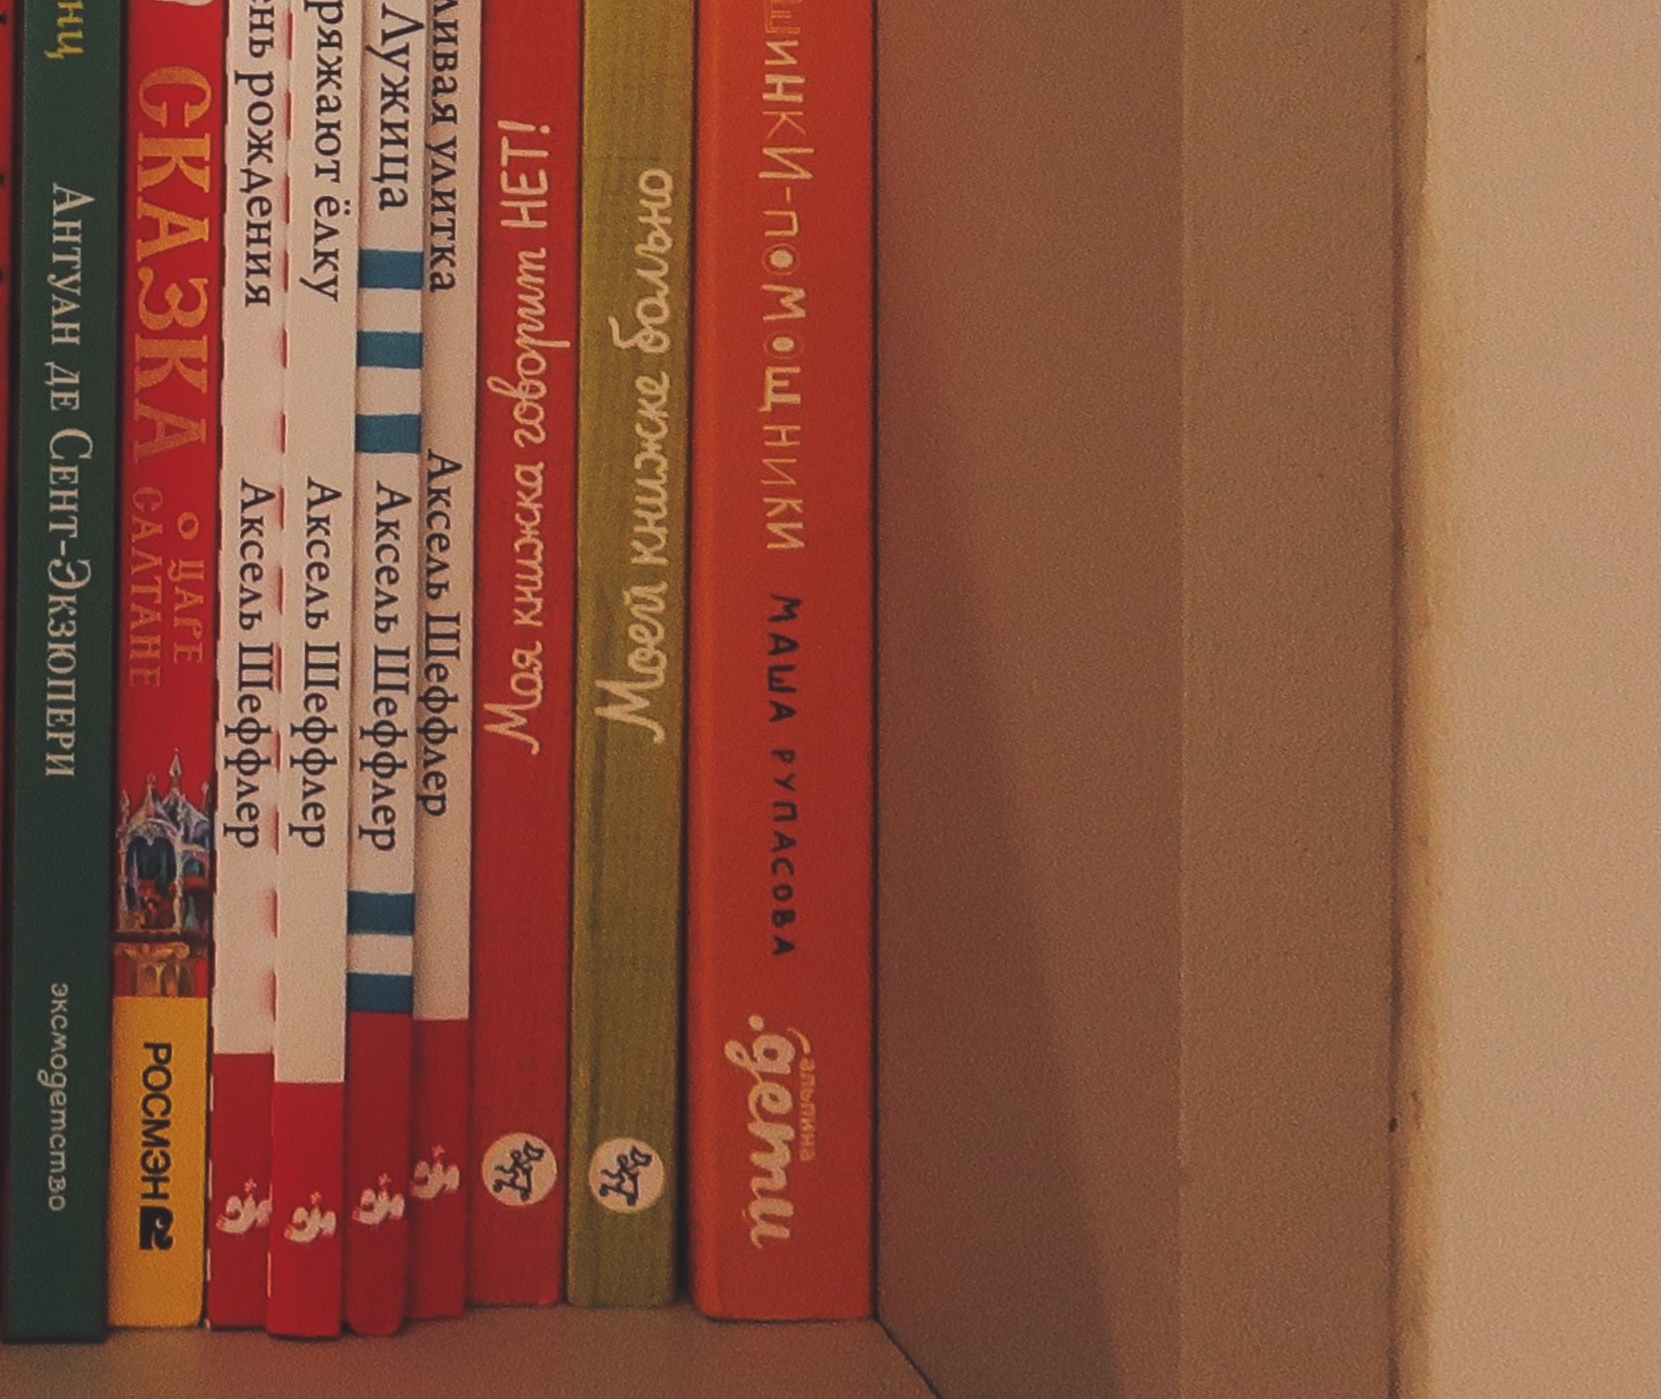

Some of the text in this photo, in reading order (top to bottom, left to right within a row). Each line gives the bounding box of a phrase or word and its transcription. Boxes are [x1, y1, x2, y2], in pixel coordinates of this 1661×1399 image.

[235, 71, 288, 307] рождения
[362, 4, 425, 210] Лужица
[299, 196, 350, 302] ёлку
[136, 71, 213, 663] СКАЗКА ЦАРЕ
[484, 120, 570, 755] Моя книжка говорит НЕТ!
[131, 488, 162, 685] САЛТАНЕ
[223, 478, 276, 848] Аксель Шеффлер
[288, 477, 342, 848] Аксель Шеффлер
[767, 595, 802, 956] МАША РУПАСОВА
[37, 983, 69, 1211] эксмодетство
[141, 1043, 171, 1200] РОСМЭН
[725, 1016, 808, 1248] .дети
[798, 1058, 816, 1162] альпина
